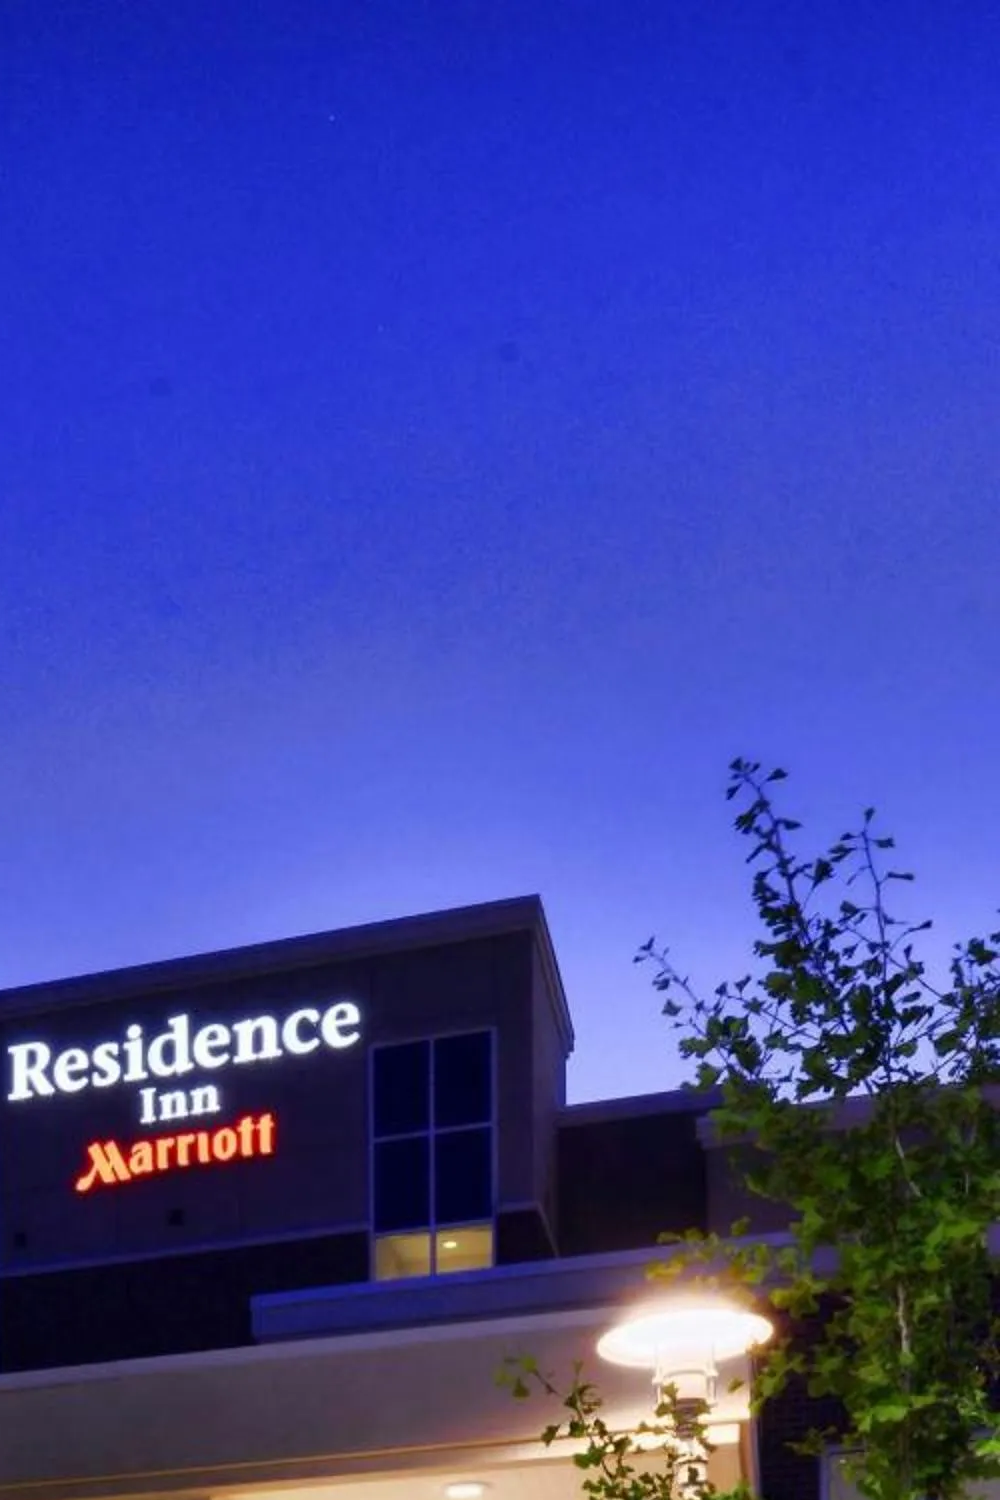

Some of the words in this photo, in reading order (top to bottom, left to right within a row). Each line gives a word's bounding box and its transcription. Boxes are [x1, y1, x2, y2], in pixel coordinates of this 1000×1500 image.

[7, 1001, 361, 1102] Residence
[139, 1083, 221, 1125] Inn
[74, 1112, 275, 1191] Marriott
